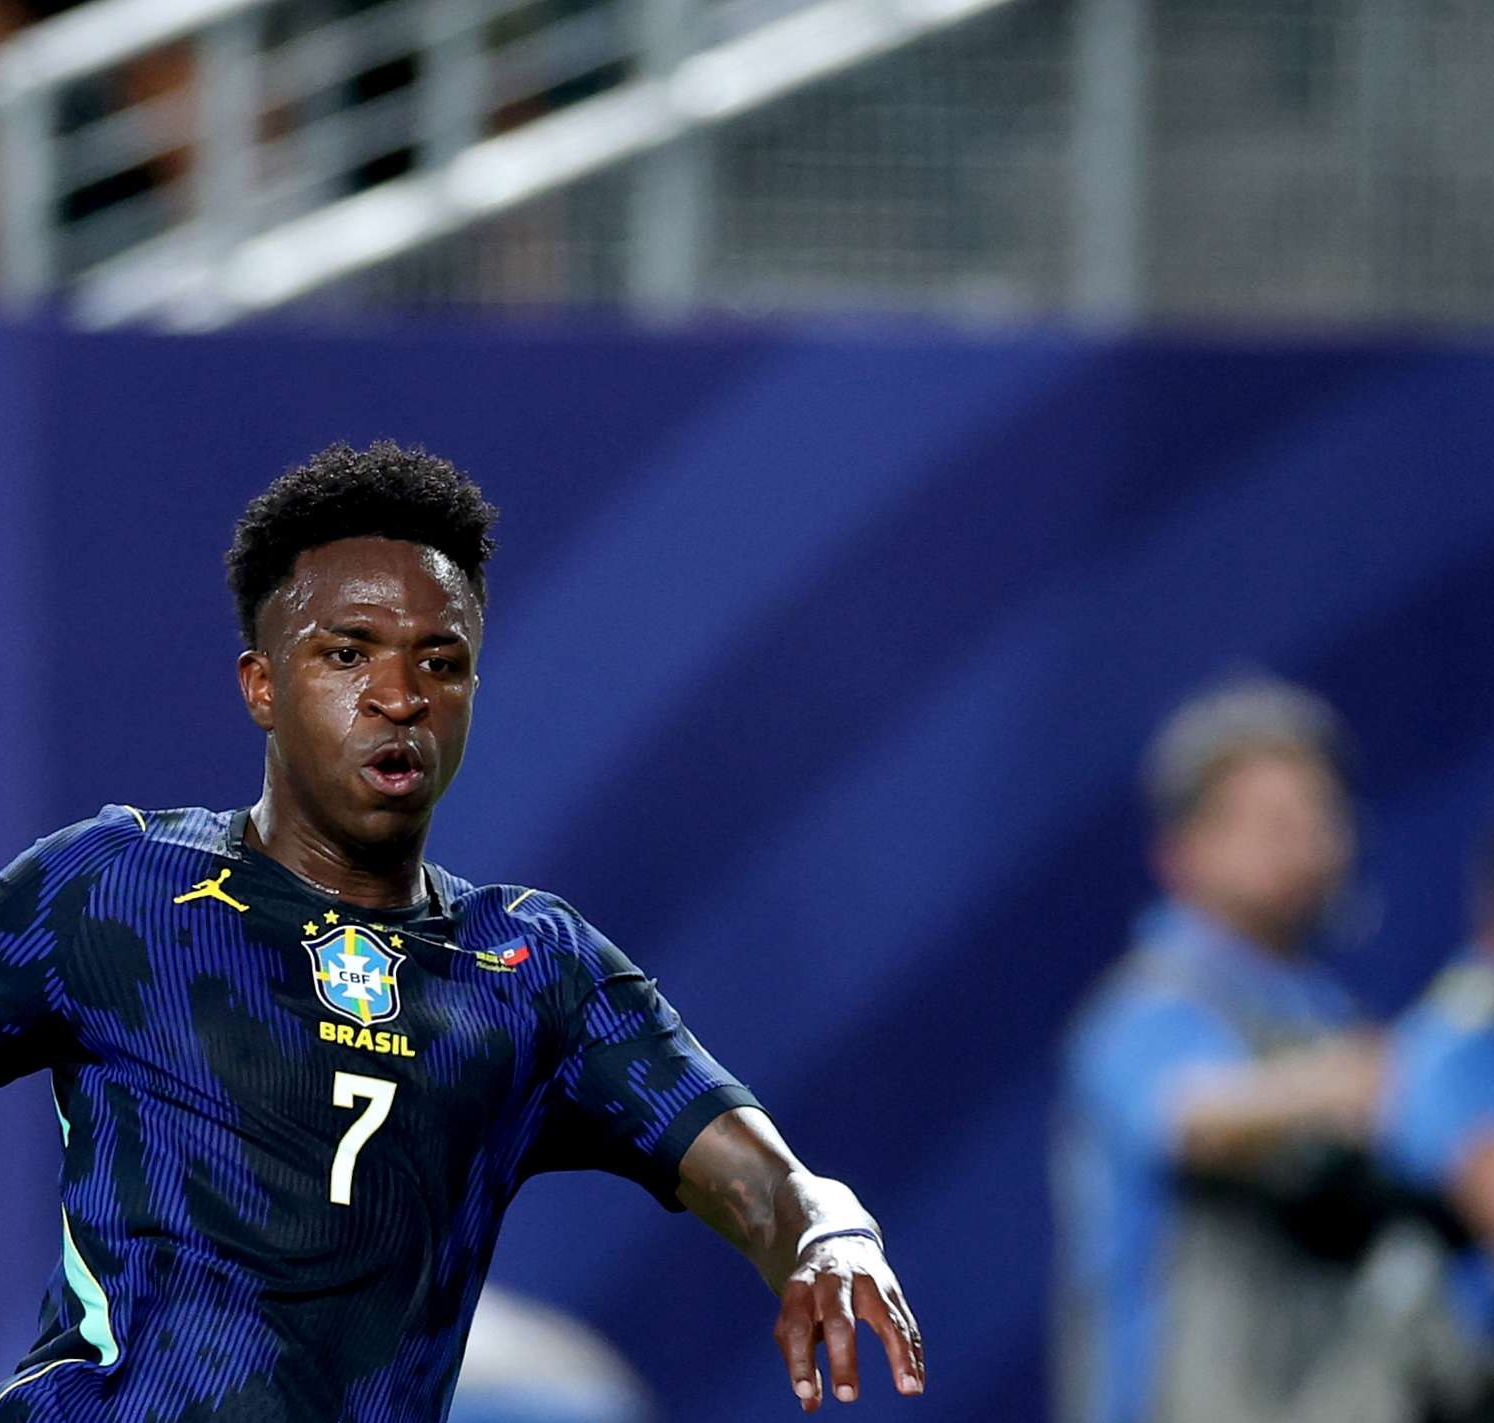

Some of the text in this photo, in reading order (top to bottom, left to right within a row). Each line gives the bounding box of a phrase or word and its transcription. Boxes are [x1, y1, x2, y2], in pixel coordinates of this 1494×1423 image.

[338, 970, 371, 985] CBF
[319, 1021, 416, 1057] BRASIL
[330, 1072, 397, 1205] 7
